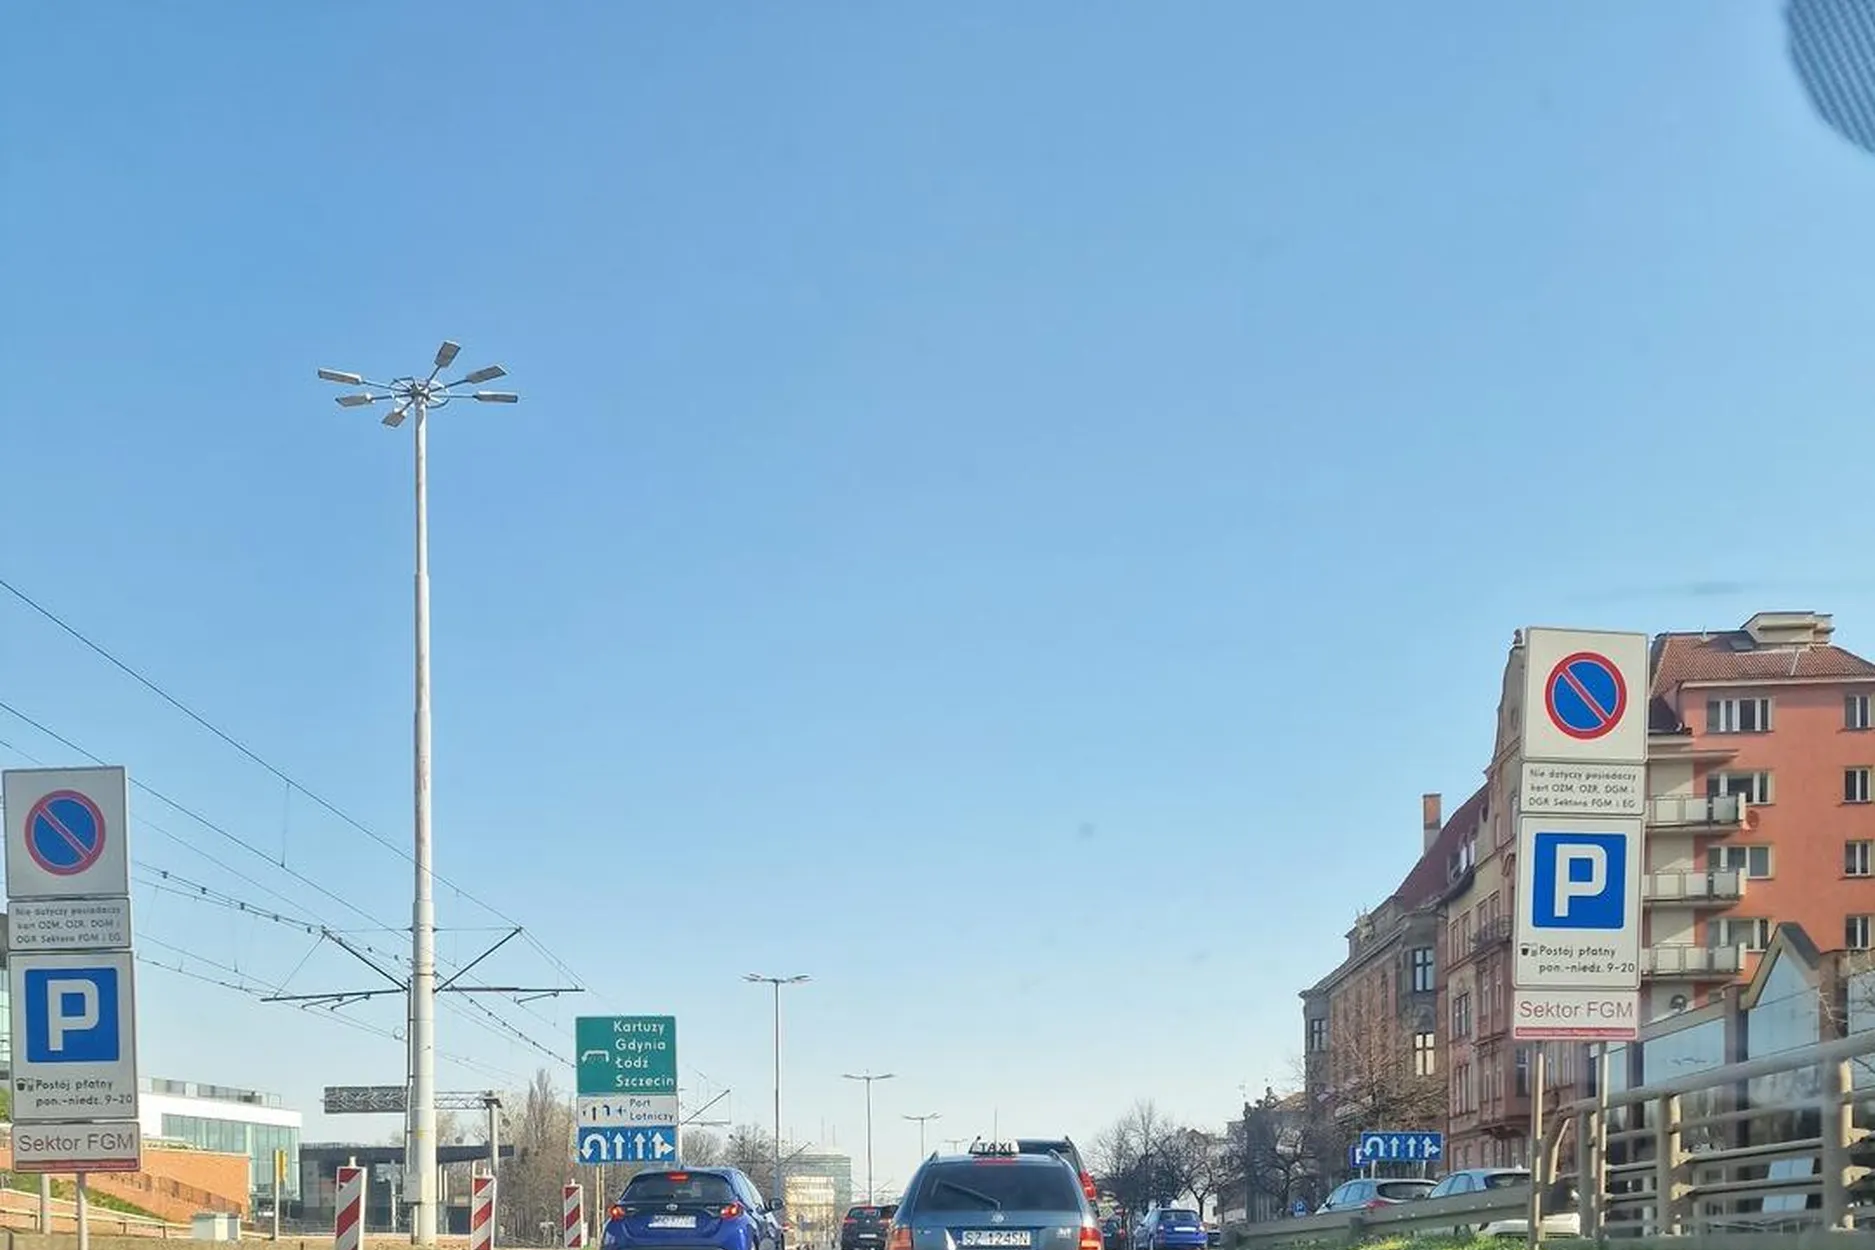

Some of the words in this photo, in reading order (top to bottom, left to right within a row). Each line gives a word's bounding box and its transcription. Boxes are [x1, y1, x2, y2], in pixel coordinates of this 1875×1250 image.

[1548, 769, 1582, 780] dotyczy
[1554, 843, 1608, 918] P
[1578, 946, 1616, 958] płatny
[1606, 962, 1635, 973] 9-20
[47, 979, 99, 1051] P
[1519, 1001, 1581, 1018] Sektor
[1586, 1001, 1633, 1018] FGM
[613, 1020, 665, 1036] Kartuzy
[615, 1038, 666, 1053] Gdynia
[615, 1055, 649, 1069] Łódź
[75, 1079, 113, 1091] płatny
[615, 1074, 674, 1087] Szczecin
[629, 1098, 651, 1107] Port
[629, 1112, 674, 1121] Lotniczy
[19, 1134, 82, 1152] Sektor
[87, 1132, 134, 1150] FGM
[979, 1142, 1011, 1152] TAXI
